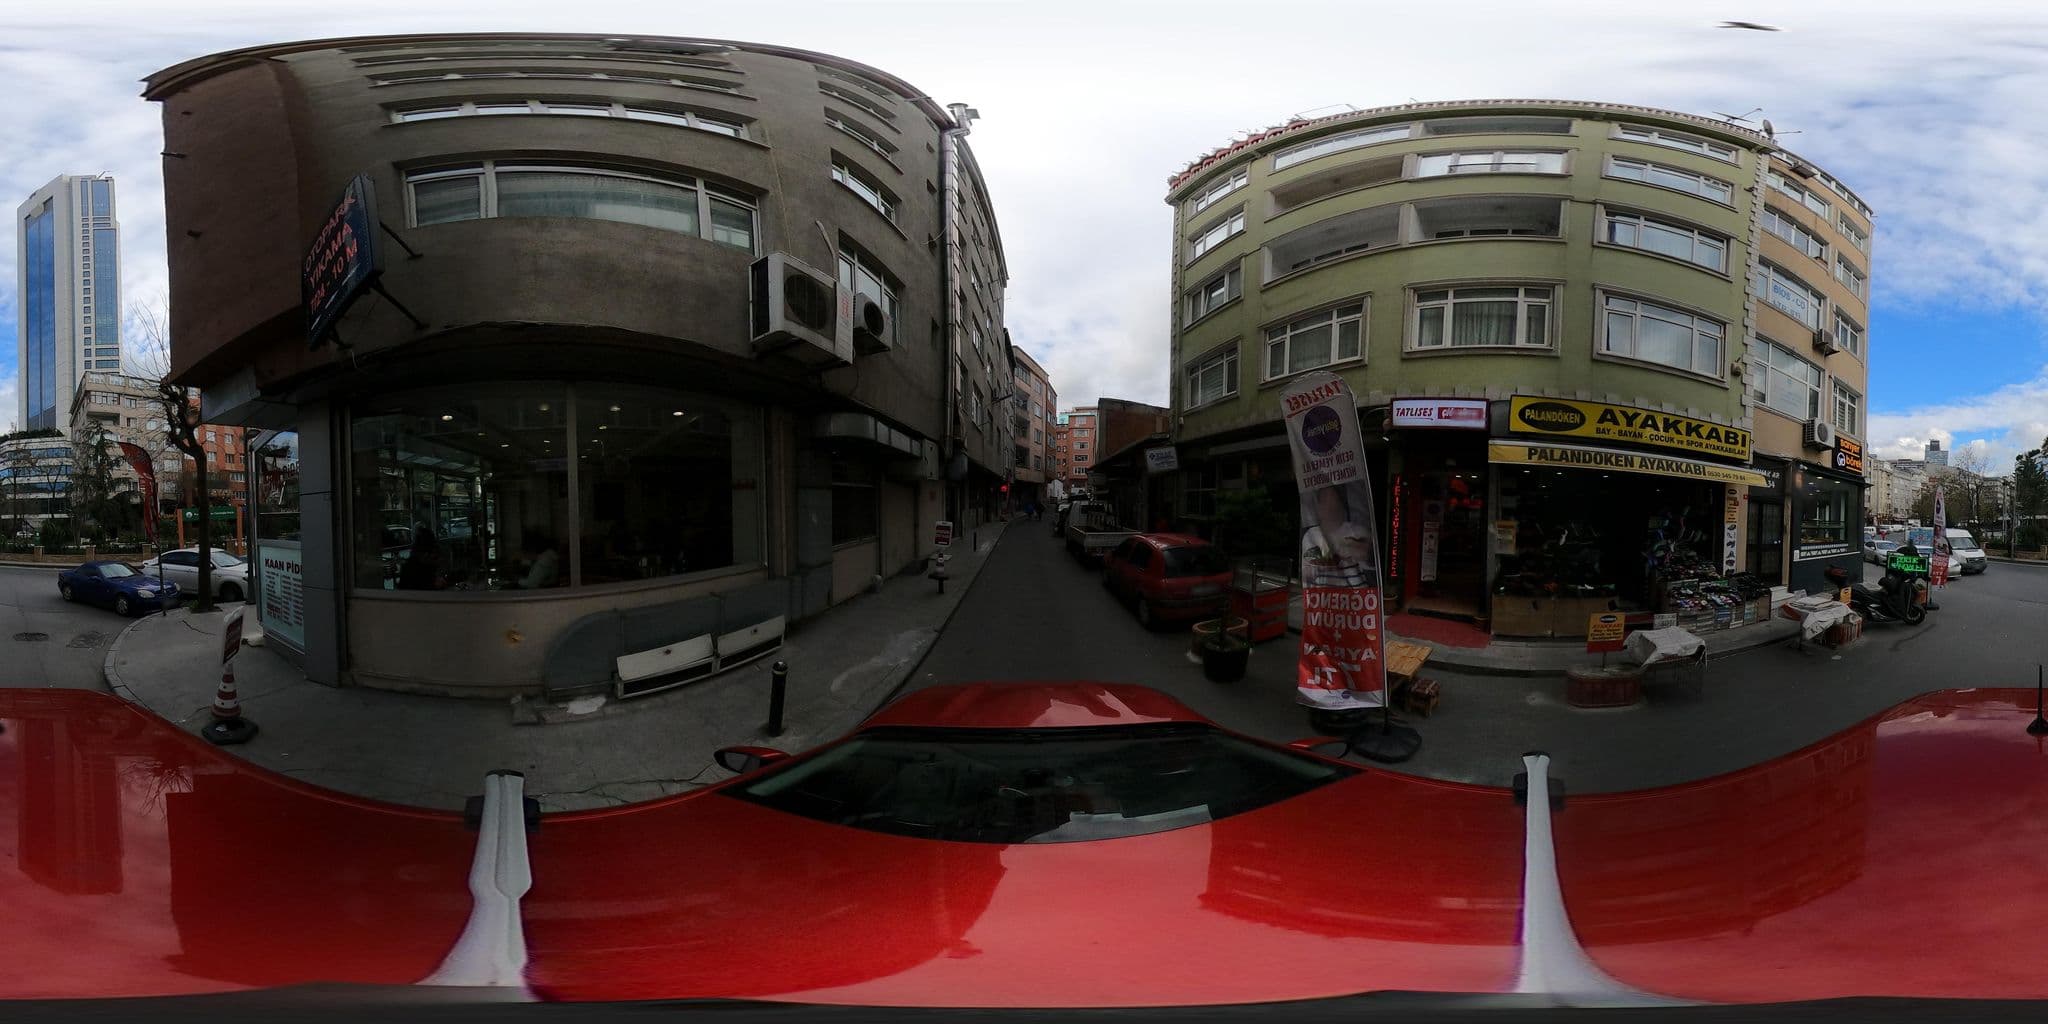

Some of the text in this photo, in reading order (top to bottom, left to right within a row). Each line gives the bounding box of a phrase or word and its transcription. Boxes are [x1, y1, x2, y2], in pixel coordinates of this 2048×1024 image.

[306, 196, 356, 272] OTOPARK
[310, 223, 352, 288] YIKAMA
[332, 256, 344, 280] 10
[1396, 407, 1433, 417] TATLISES
[1525, 408, 1581, 424] PALANDÖKEN
[1596, 427, 1611, 435] BAY
[1618, 429, 1643, 439] BAYAN
[1649, 434, 1674, 443] ÇOCUK
[1687, 439, 1703, 448] SPOR
[1597, 408, 1747, 448] AYAKKABI
[1639, 456, 1706, 476] AYAKKABI
[265, 558, 284, 571] KAAN
